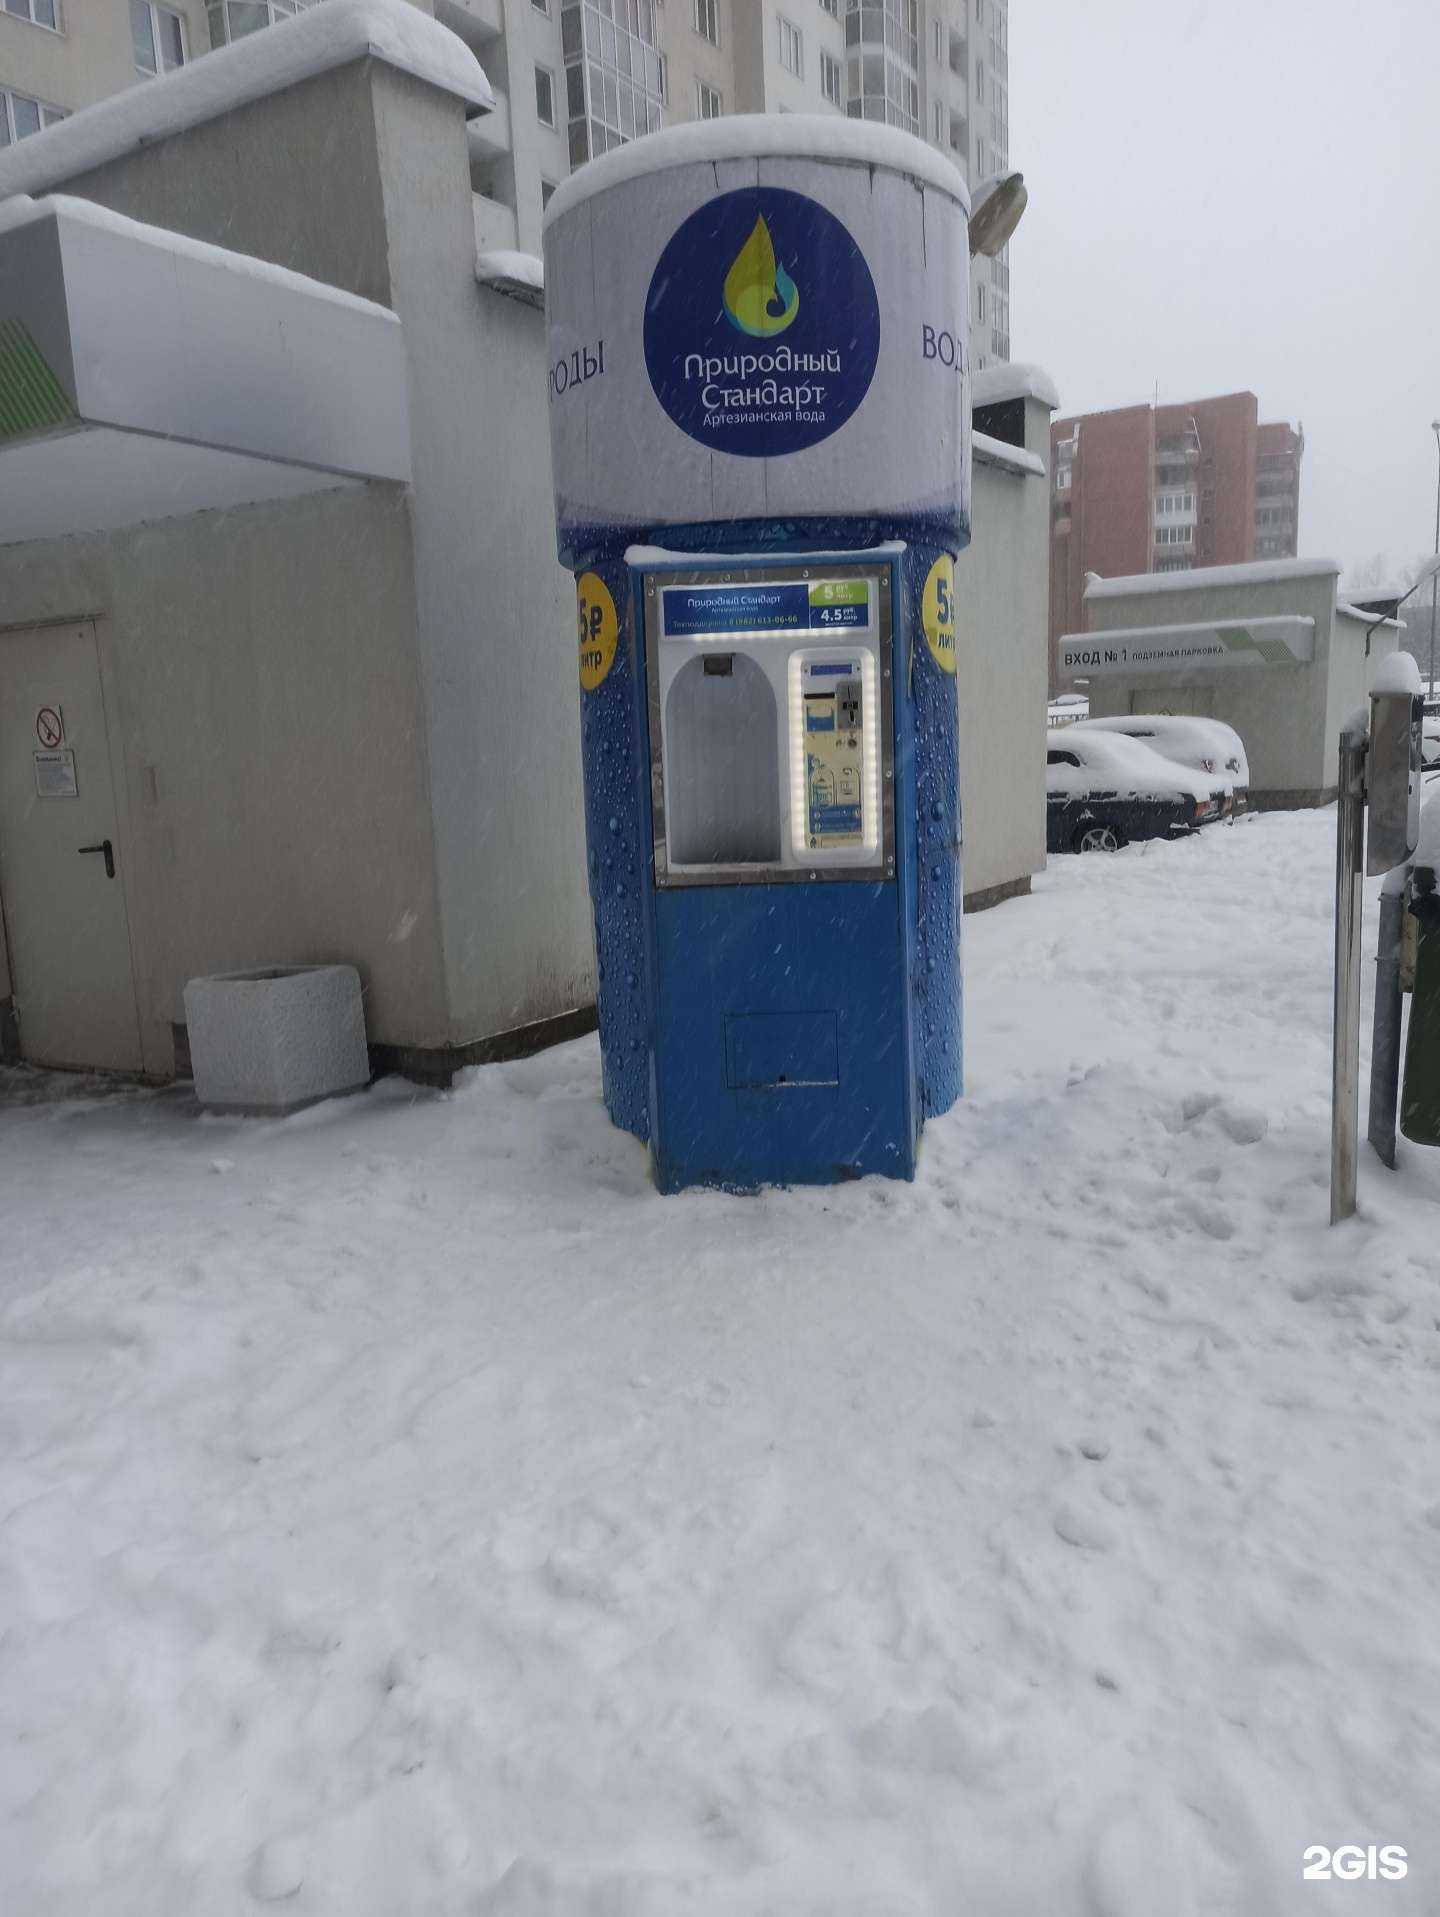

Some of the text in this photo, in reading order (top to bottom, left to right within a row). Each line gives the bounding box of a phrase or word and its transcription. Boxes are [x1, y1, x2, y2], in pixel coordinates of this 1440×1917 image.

[683, 345, 841, 383] Природный
[701, 379, 826, 411] Стандарт
[703, 410, 826, 428] Артезианская вода
[820, 608, 843, 622] 4.5
[1064, 651, 1101, 666] ВХОД
[1121, 649, 1128, 661] 1
[1181, 646, 1225, 657] ПАРКОВКА
